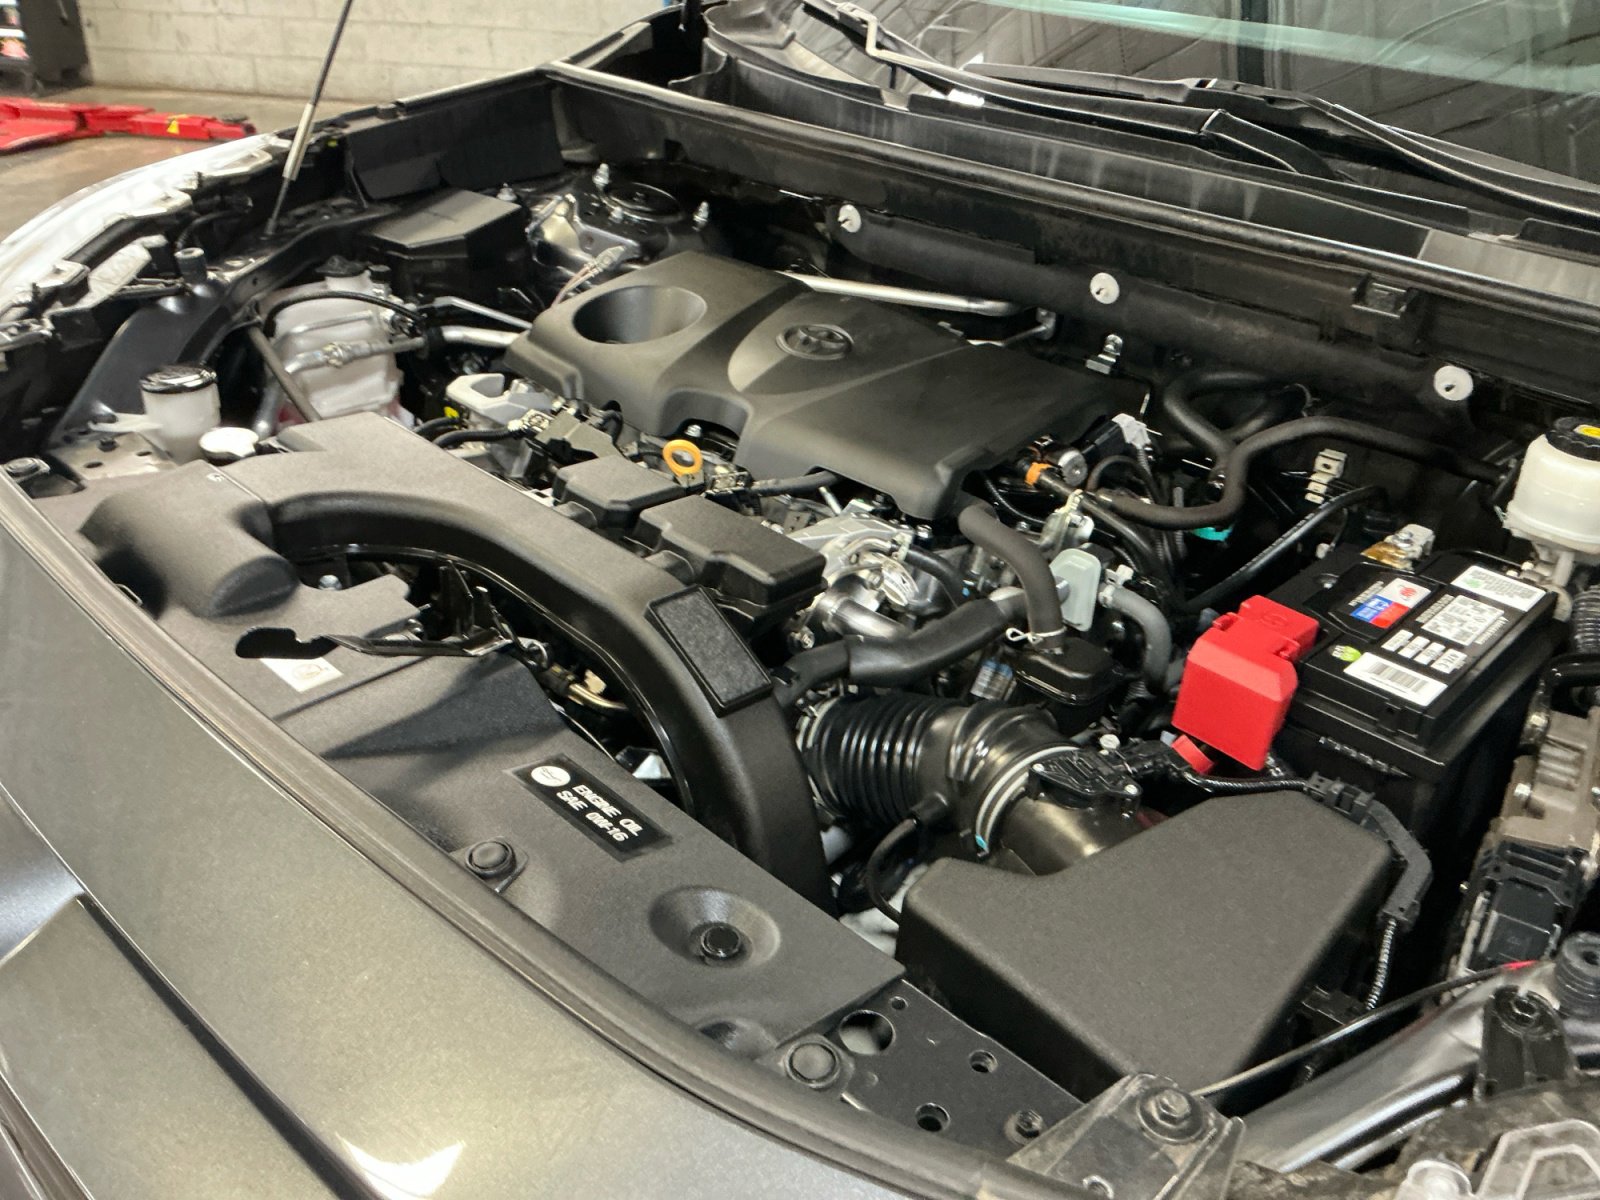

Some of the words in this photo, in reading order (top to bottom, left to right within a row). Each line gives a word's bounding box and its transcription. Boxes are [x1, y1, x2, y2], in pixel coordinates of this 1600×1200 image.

[556, 790, 589, 812] SAE
[572, 784, 622, 818] ENGINE
[619, 818, 644, 837] OIL
